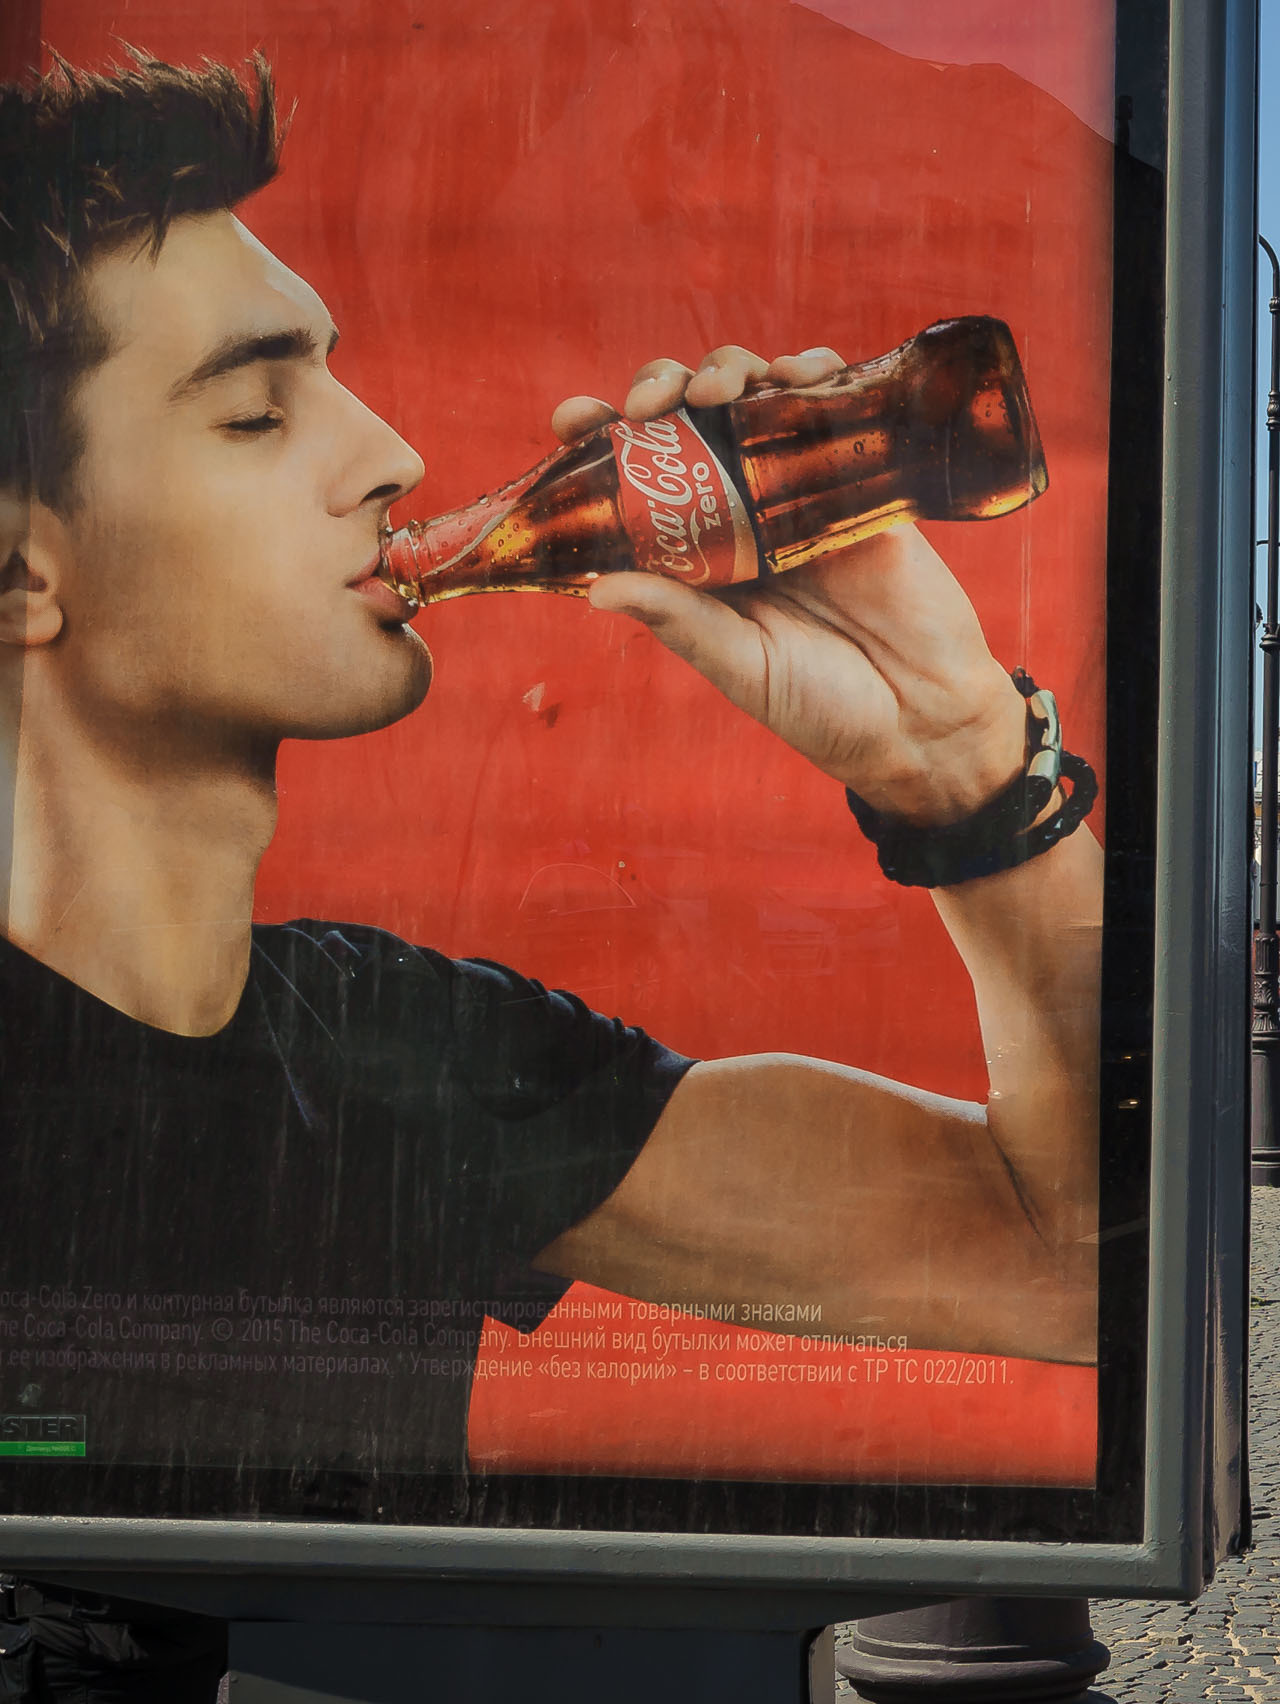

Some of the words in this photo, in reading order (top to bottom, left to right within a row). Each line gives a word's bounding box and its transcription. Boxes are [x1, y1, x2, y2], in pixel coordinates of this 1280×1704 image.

[614, 418, 709, 582] oca-Cola
[692, 461, 722, 530] zero
[0, 1285, 77, 1310] oca-Cola
[81, 1285, 122, 1310] Zero
[126, 1293, 137, 1310] и
[142, 1293, 235, 1318] контурная
[239, 1287, 314, 1319] бутылка
[318, 1296, 404, 1317] являются
[407, 1299, 623, 1325] зарегистрированными
[629, 1301, 735, 1325] товарными
[740, 1302, 822, 1322] знаками
[24, 1313, 114, 1339] Coca-Cola
[119, 1315, 204, 1347] Company.
[241, 1317, 283, 1343] 2015
[289, 1318, 321, 1344] The
[326, 1319, 418, 1346] Coca-Cola
[424, 1321, 511, 1353] Company.
[518, 1325, 606, 1349] Внешний
[612, 1332, 647, 1353] вид
[653, 1326, 730, 1356] бутылки
[736, 1334, 796, 1352] может
[800, 1334, 908, 1353] отличаться
[35, 1343, 156, 1374] изображения
[160, 1352, 171, 1371] в
[176, 1352, 277, 1376] рекламных
[409, 1351, 533, 1382] Утверждение
[538, 1354, 581, 1377] «без
[587, 1357, 677, 1385] калорий»
[700, 1363, 710, 1381] в
[715, 1363, 842, 1382] соответствии
[848, 1364, 858, 1382] с
[863, 1358, 888, 1382] ТР
[894, 1359, 918, 1383] ТС
[923, 1357, 1014, 1385] 022/2011.
[2, 1415, 79, 1439] STER
